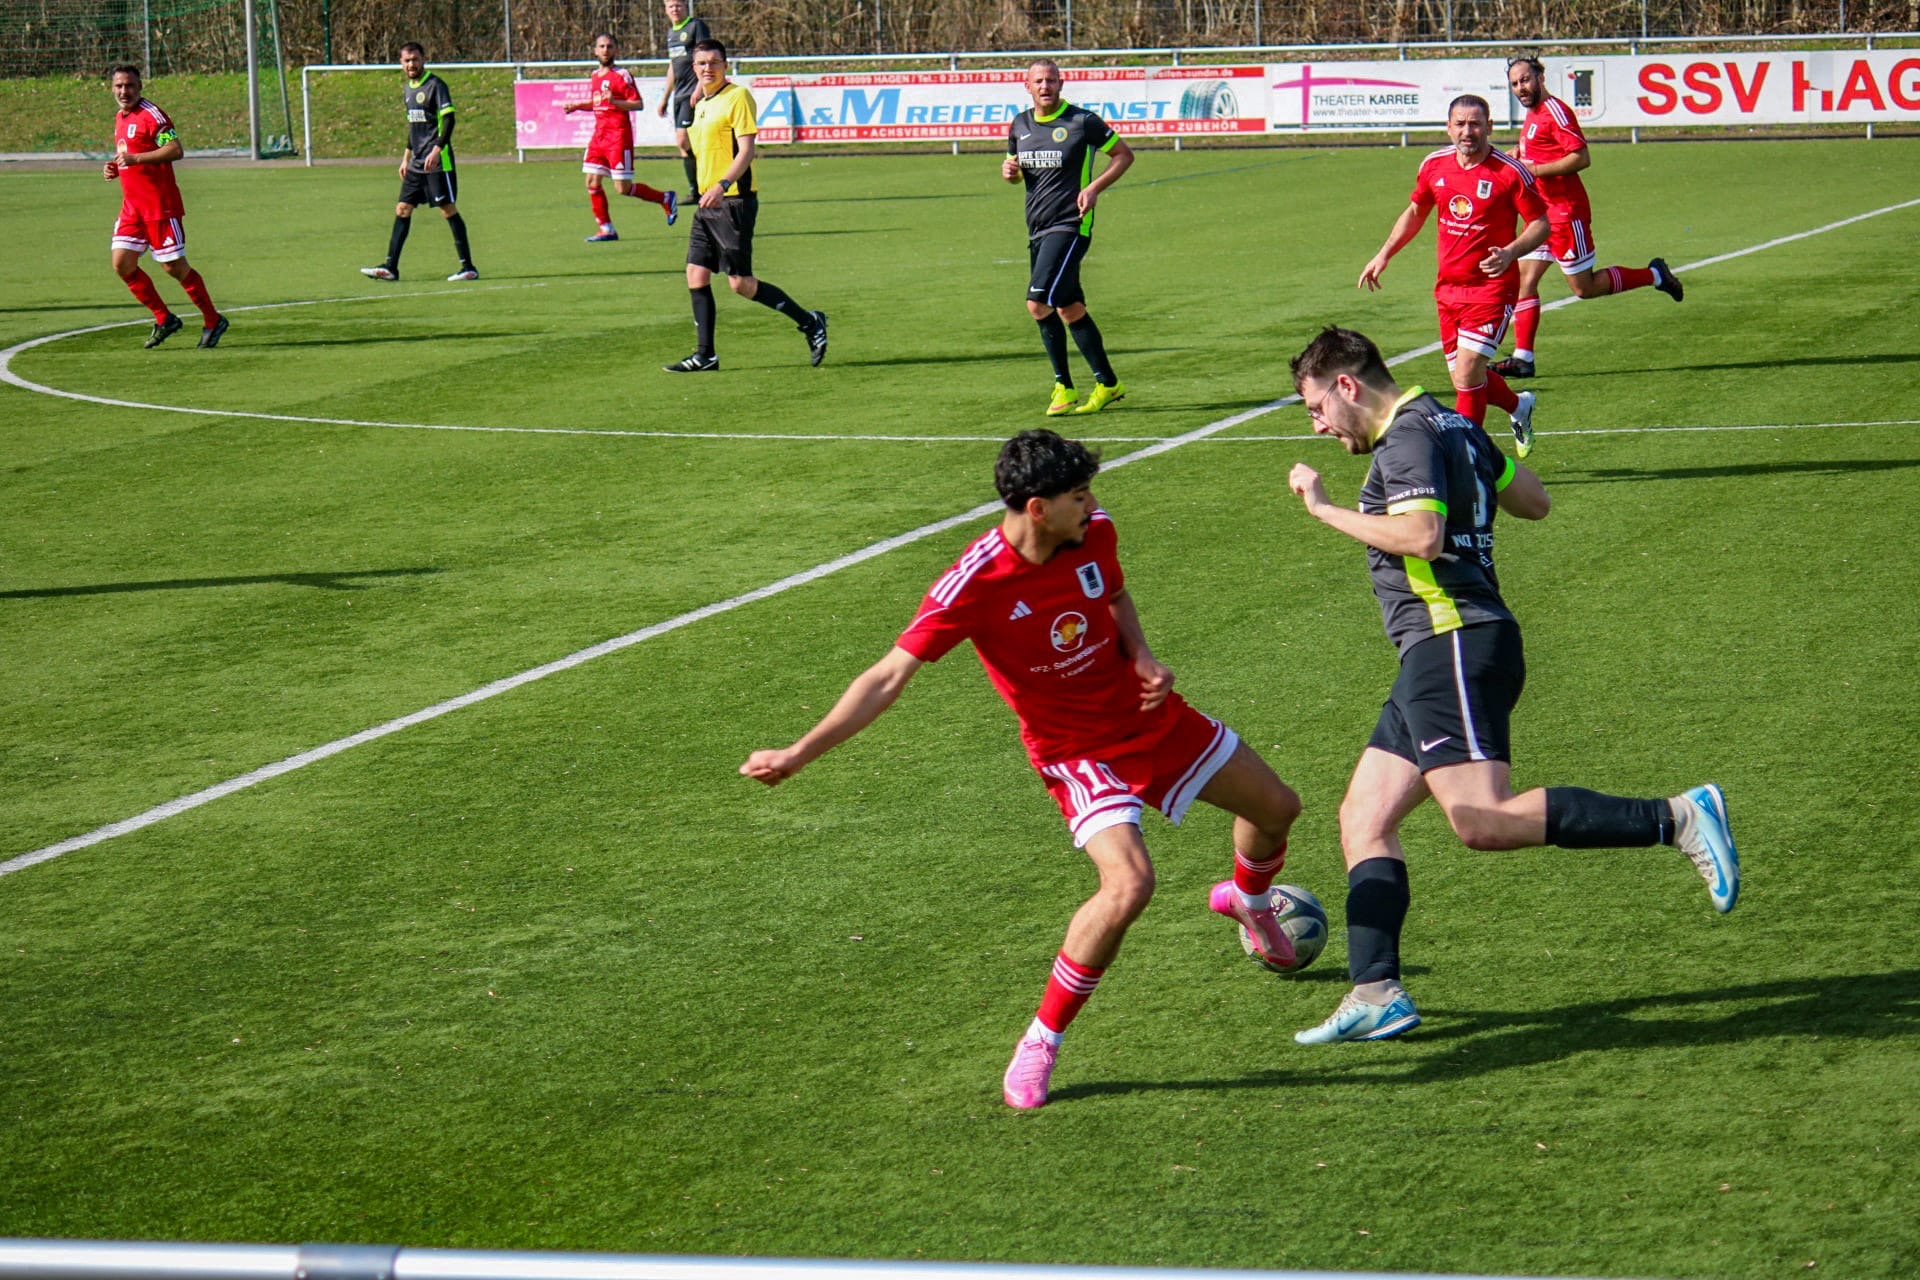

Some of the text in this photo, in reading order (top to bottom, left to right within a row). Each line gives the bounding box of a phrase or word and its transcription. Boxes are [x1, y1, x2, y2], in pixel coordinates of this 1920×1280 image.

[874, 74, 909, 84] HAGEN
[1636, 61, 1771, 116] SSV
[1313, 94, 1419, 106] THEATER KARREE
[757, 88, 901, 126] A&M
[1313, 106, 1420, 117] www.theater-karree.de
[1177, 119, 1239, 131] ZUBEHÖR
[808, 128, 857, 138] FELGEN
[870, 126, 990, 137] ACHSVERMESSUNG
